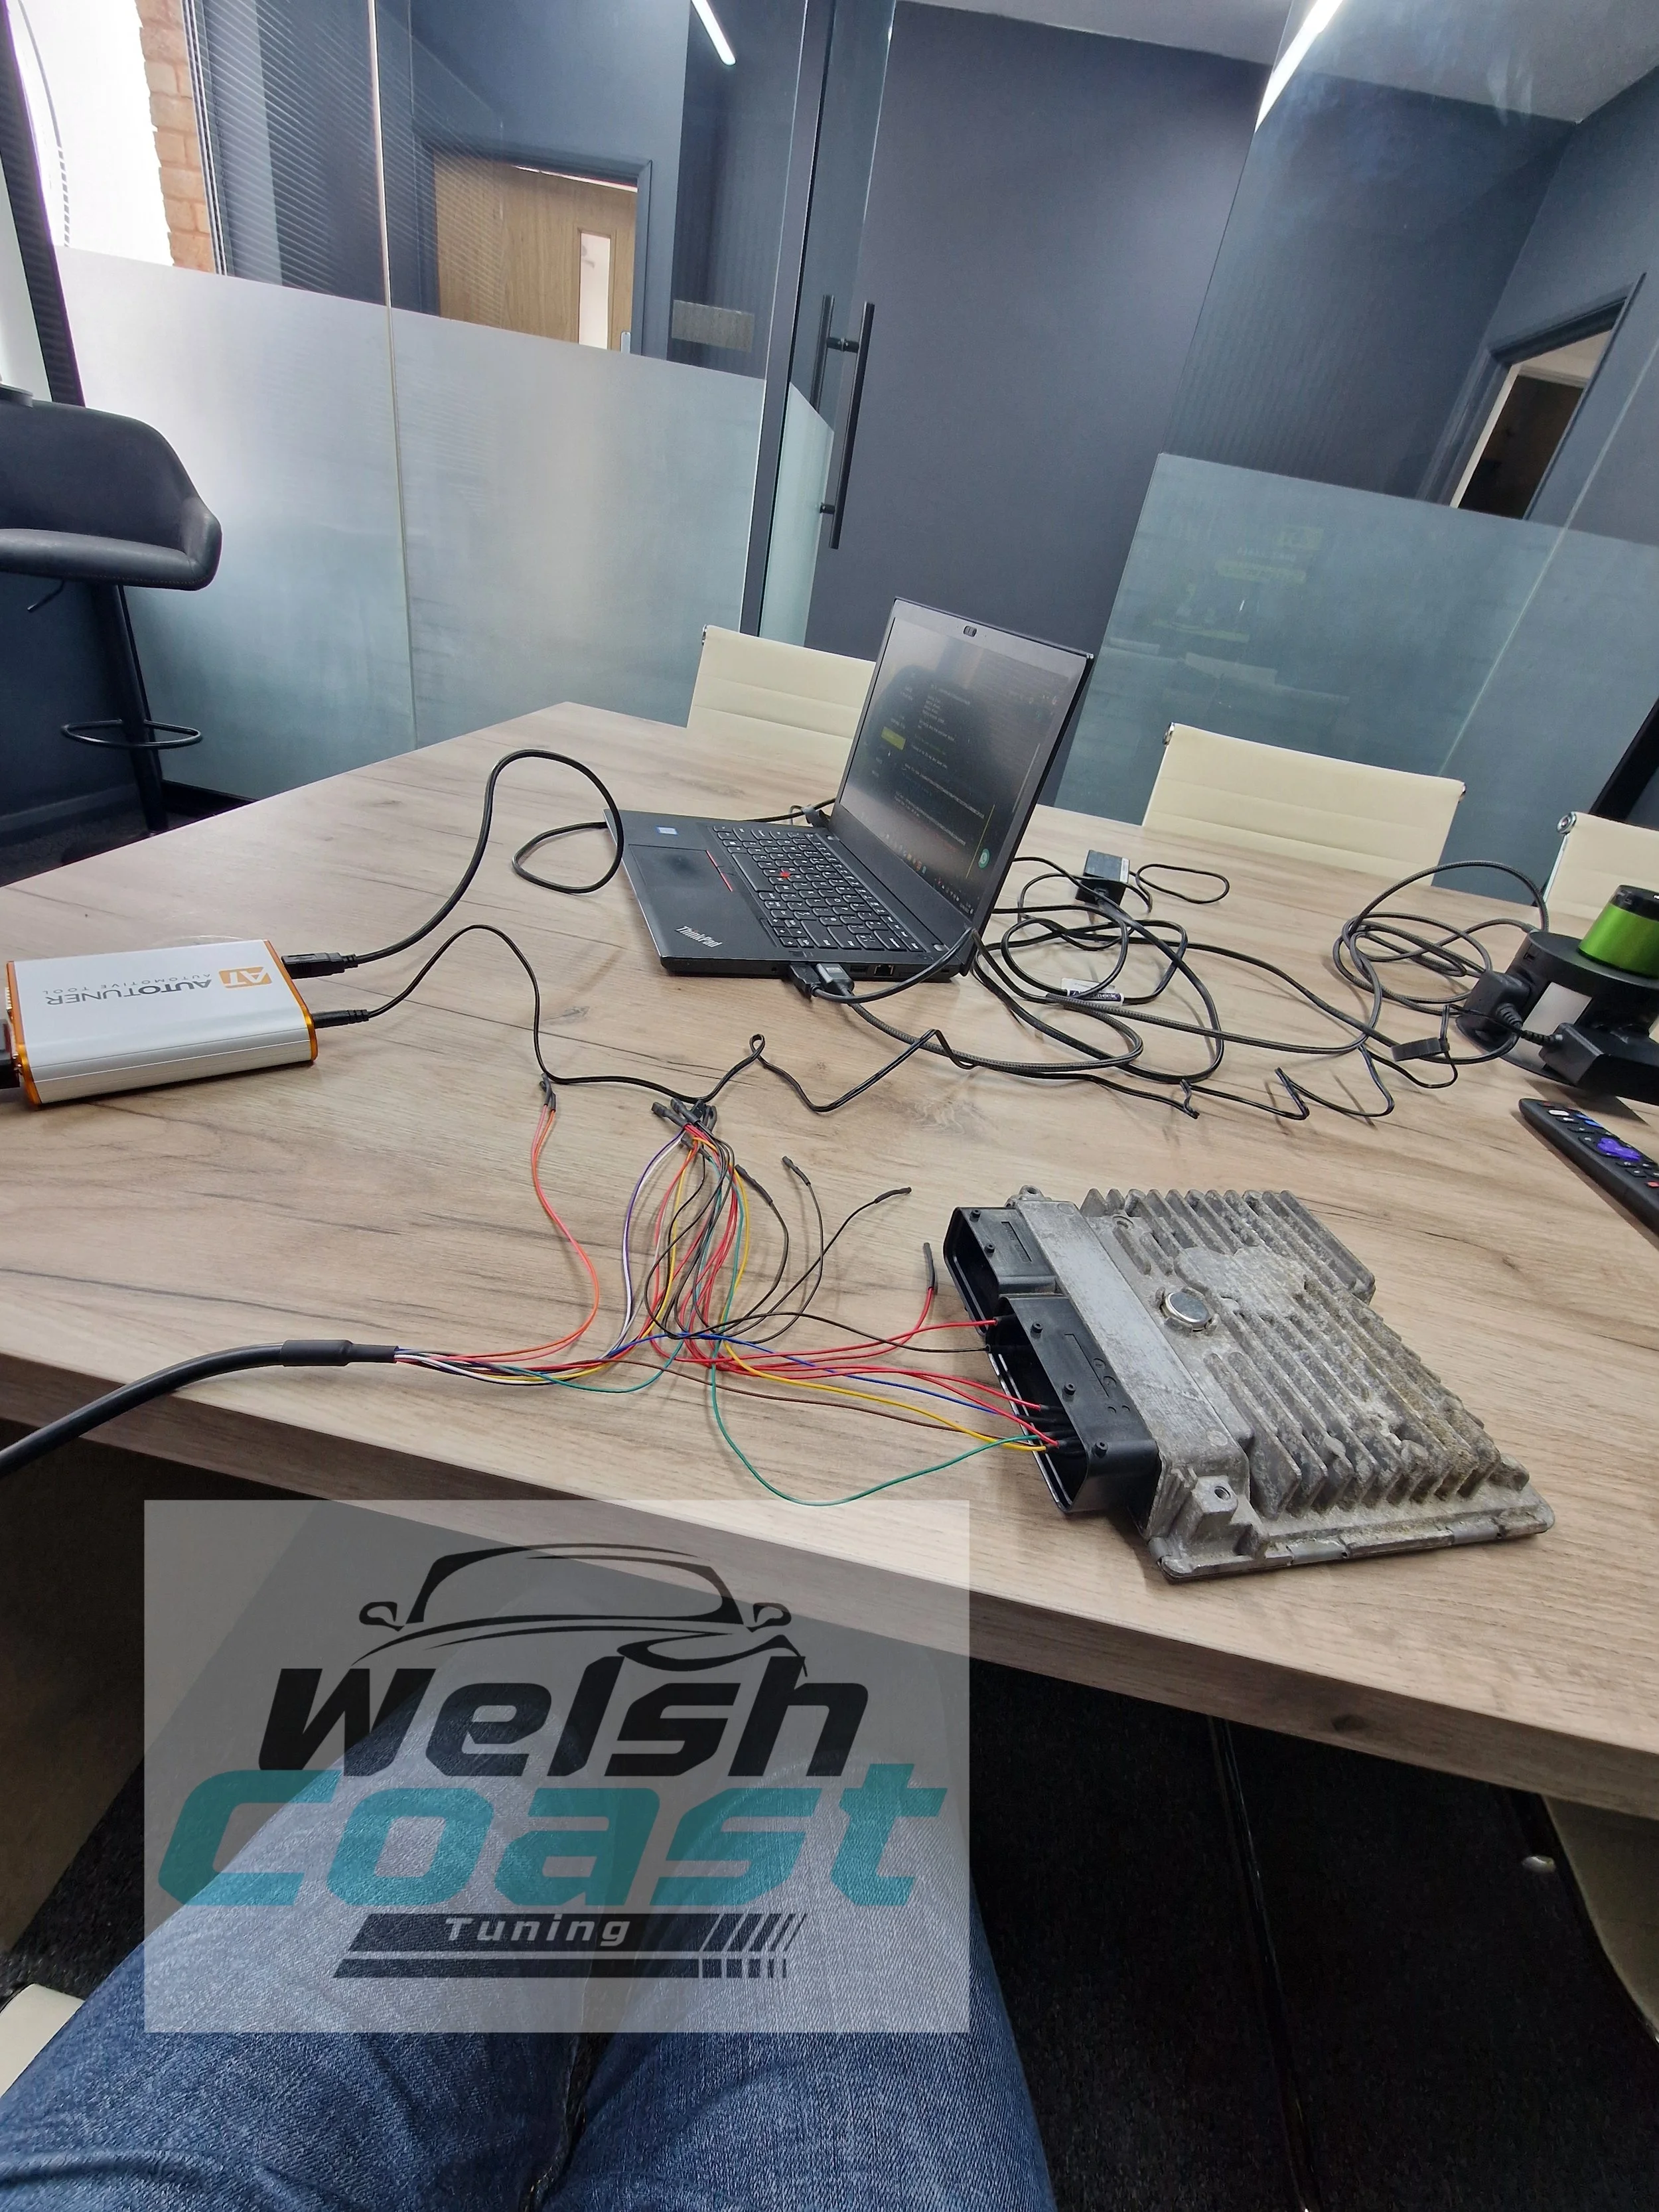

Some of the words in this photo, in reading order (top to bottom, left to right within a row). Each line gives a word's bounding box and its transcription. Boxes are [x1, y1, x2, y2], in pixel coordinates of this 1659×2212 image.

[676, 926, 723, 948] ThinkPad
[45, 980, 212, 1005] AUTOTUNER
[101, 974, 210, 989] AUTOMOTIVE
